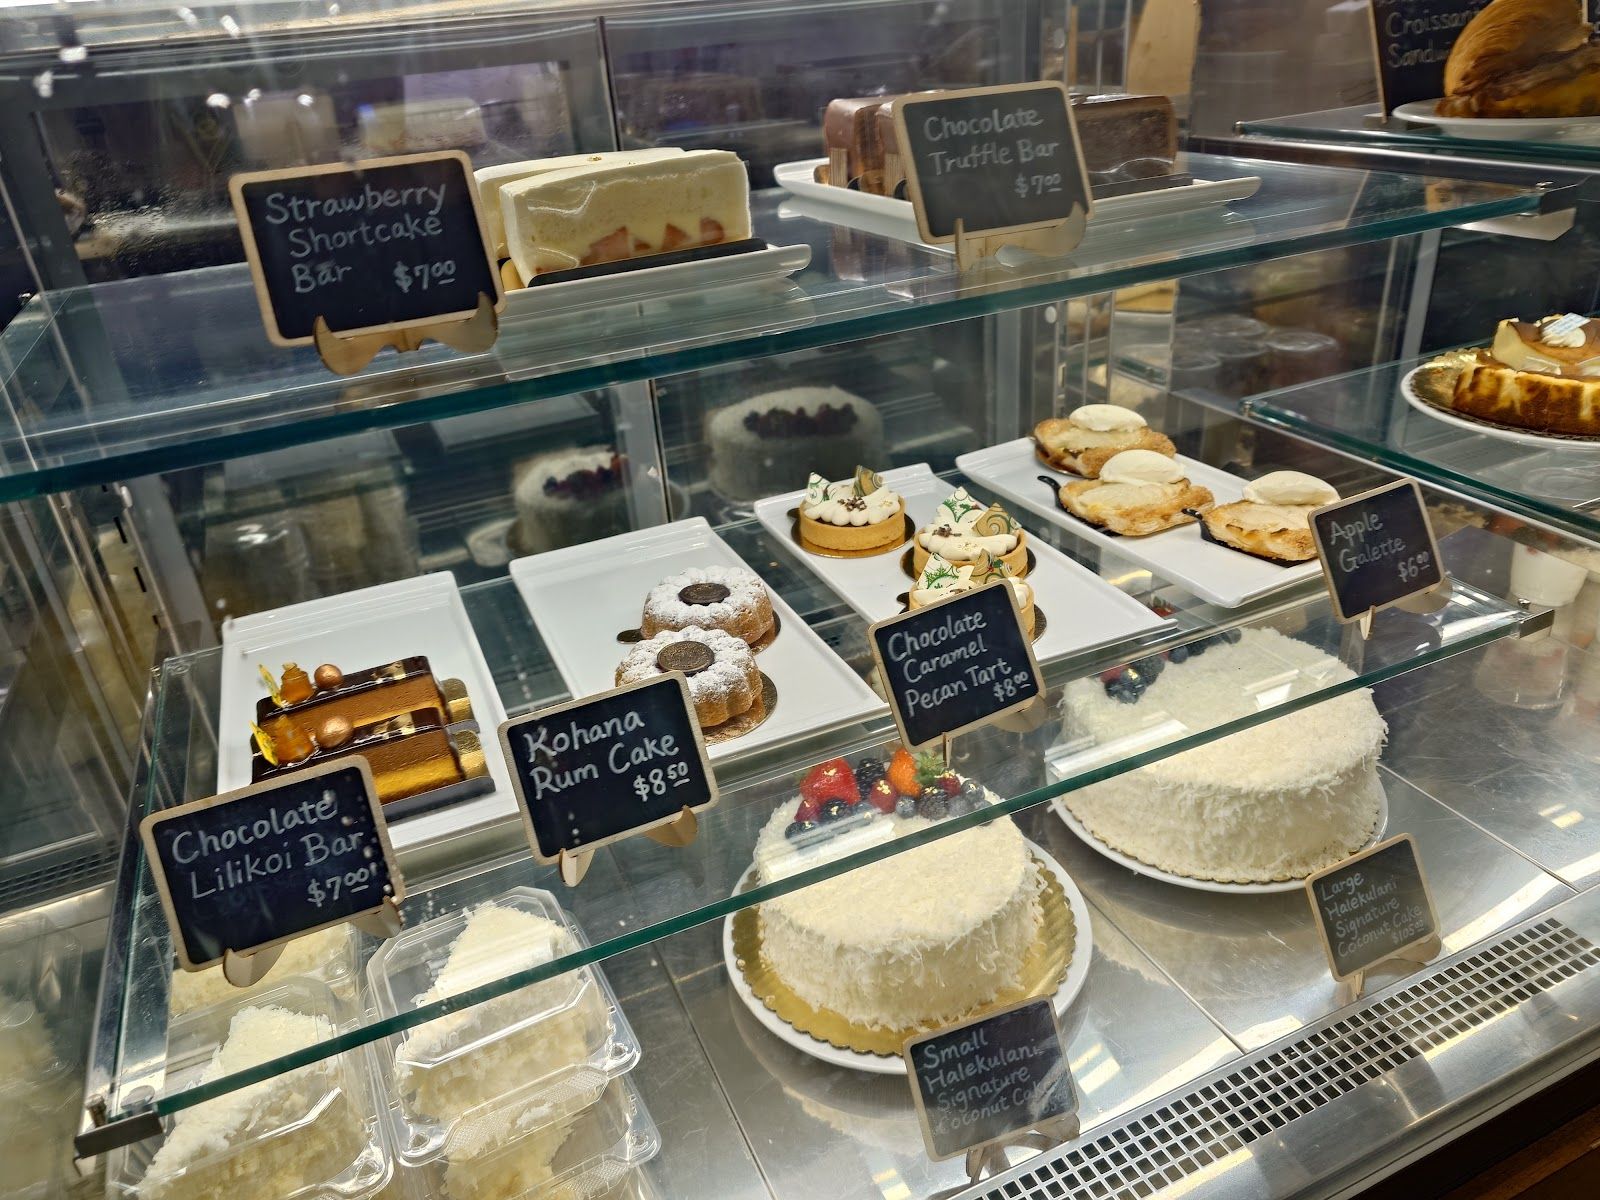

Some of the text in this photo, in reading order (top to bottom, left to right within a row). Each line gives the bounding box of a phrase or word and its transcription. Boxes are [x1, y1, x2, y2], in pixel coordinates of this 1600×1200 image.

[1385, 8, 1481, 37] Croissan
[923, 108, 1044, 142] Chocolate
[928, 139, 1060, 176] Truffle Bar
[265, 184, 446, 224] Strawberry
[288, 213, 443, 258] Shortcake
[291, 261, 353, 293] Bar
[1330, 512, 1383, 546] Apple
[1339, 537, 1406, 573] Galette
[887, 611, 987, 662] Chocolate
[903, 633, 988, 683] Caramel
[904, 658, 1012, 718] Pecan Tart
[523, 711, 645, 763] Kohana
[528, 734, 679, 800] Rum Cake
[172, 798, 338, 864] Chocolate
[190, 832, 364, 900] Lilikoi Bar
[1321, 872, 1364, 901] Large
[1325, 874, 1398, 920] Halekulani
[1335, 897, 1400, 940] Signature
[1337, 905, 1422, 957] Coconut Cake
[923, 1028, 988, 1069] Small
[924, 1038, 1041, 1094] Halekulani
[937, 1066, 1031, 1113] Signature
[938, 1096, 1010, 1135] Coconut
